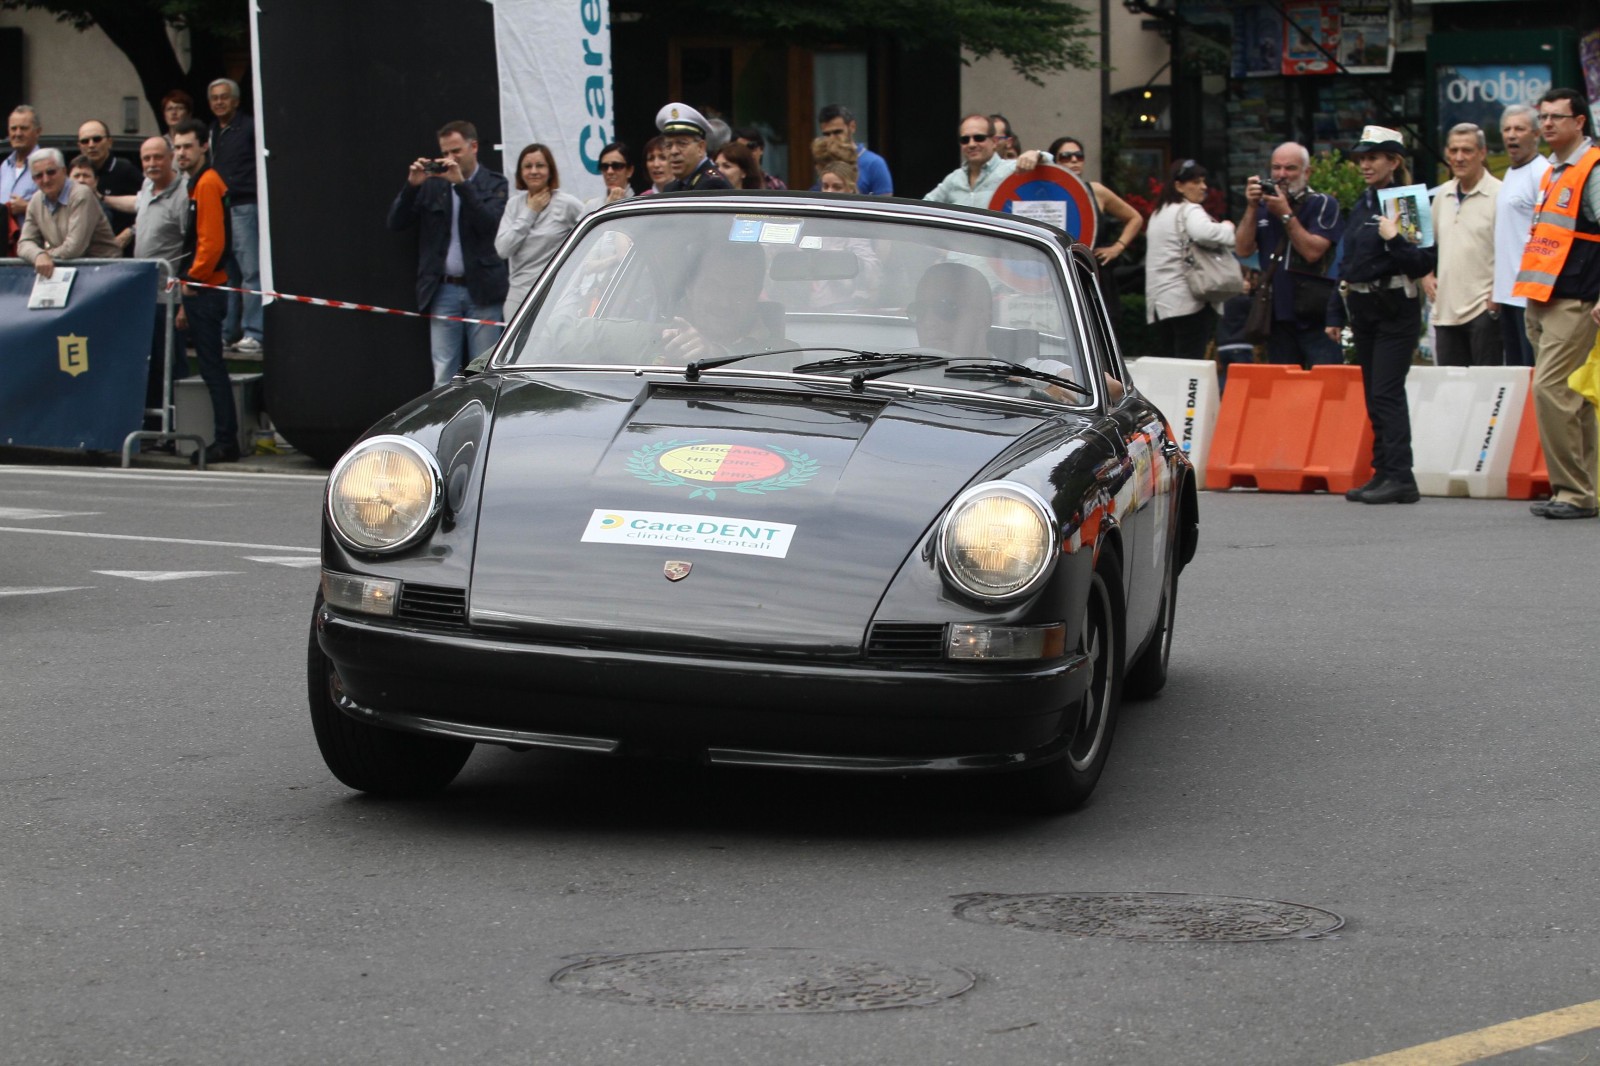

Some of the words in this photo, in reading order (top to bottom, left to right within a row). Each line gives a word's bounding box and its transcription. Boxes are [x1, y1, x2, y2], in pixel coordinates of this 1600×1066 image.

[579, 0, 607, 175] Care
[1446, 69, 1552, 103] orobie
[67, 343, 80, 366] E
[690, 446, 770, 456] BERGAMO
[687, 457, 761, 467] HISTORIC
[671, 468, 717, 476] GRAN
[721, 471, 756, 479] PRIX
[626, 531, 696, 543] cliniche
[703, 536, 770, 550] dentali
